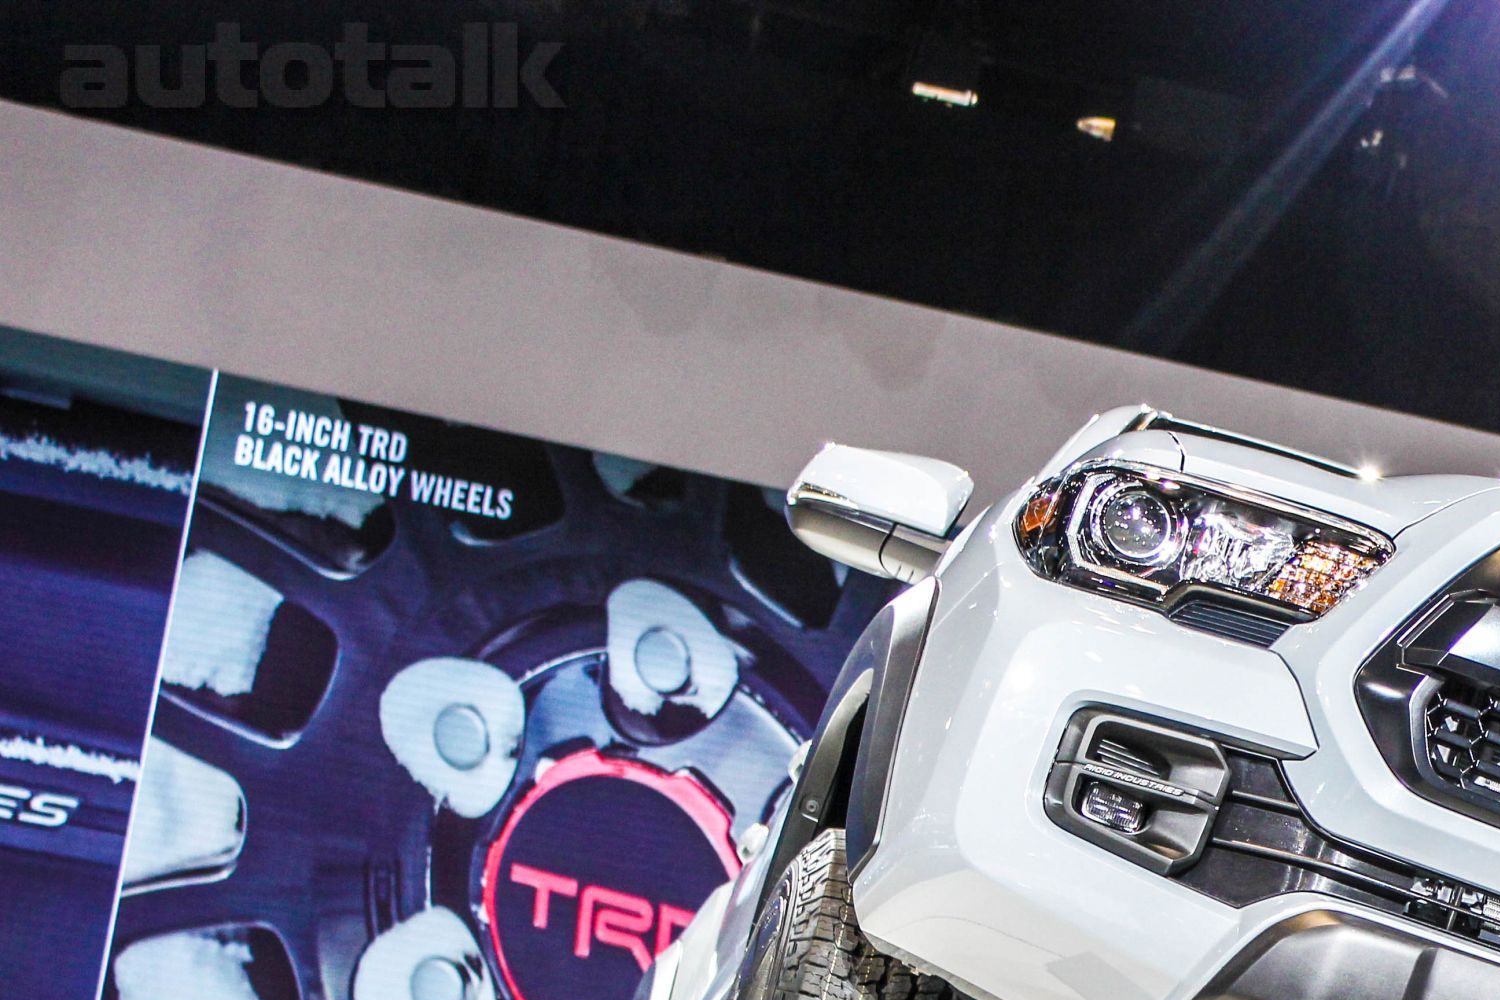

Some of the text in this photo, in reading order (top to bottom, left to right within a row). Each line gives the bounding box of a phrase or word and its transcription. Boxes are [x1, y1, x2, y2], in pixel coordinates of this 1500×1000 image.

[244, 401, 408, 463] 16-INCH TRD
[234, 434, 514, 520] BLACK ALLOY WHEELS
[1083, 763, 1185, 797] RIGID INDUSTRIES
